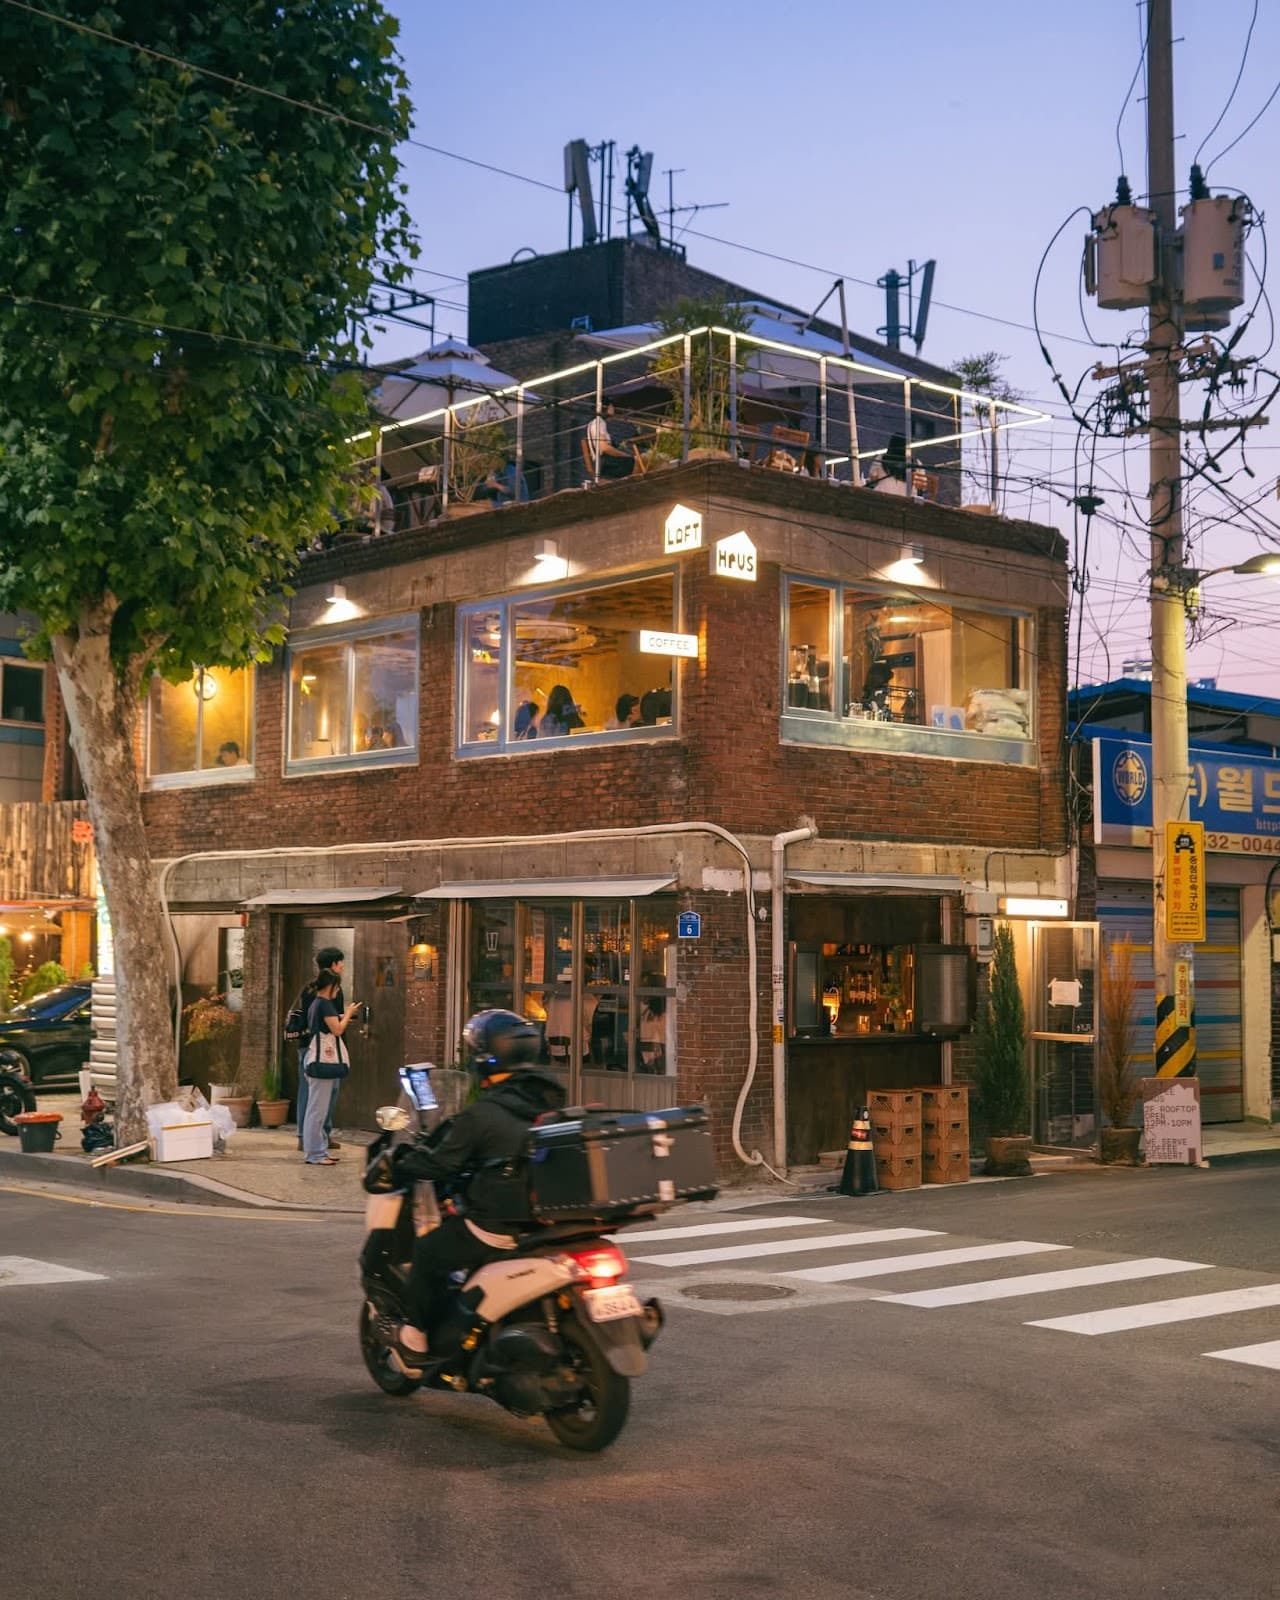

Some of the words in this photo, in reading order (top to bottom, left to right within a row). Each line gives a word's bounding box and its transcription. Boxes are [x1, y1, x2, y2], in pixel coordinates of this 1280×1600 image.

[667, 522, 700, 546] LOFT
[648, 637, 690, 650] COFFEE
[1117, 770, 1143, 786] WORLD
[686, 924, 692, 934] 6
[1160, 1105, 1197, 1113] ROOFTOP
